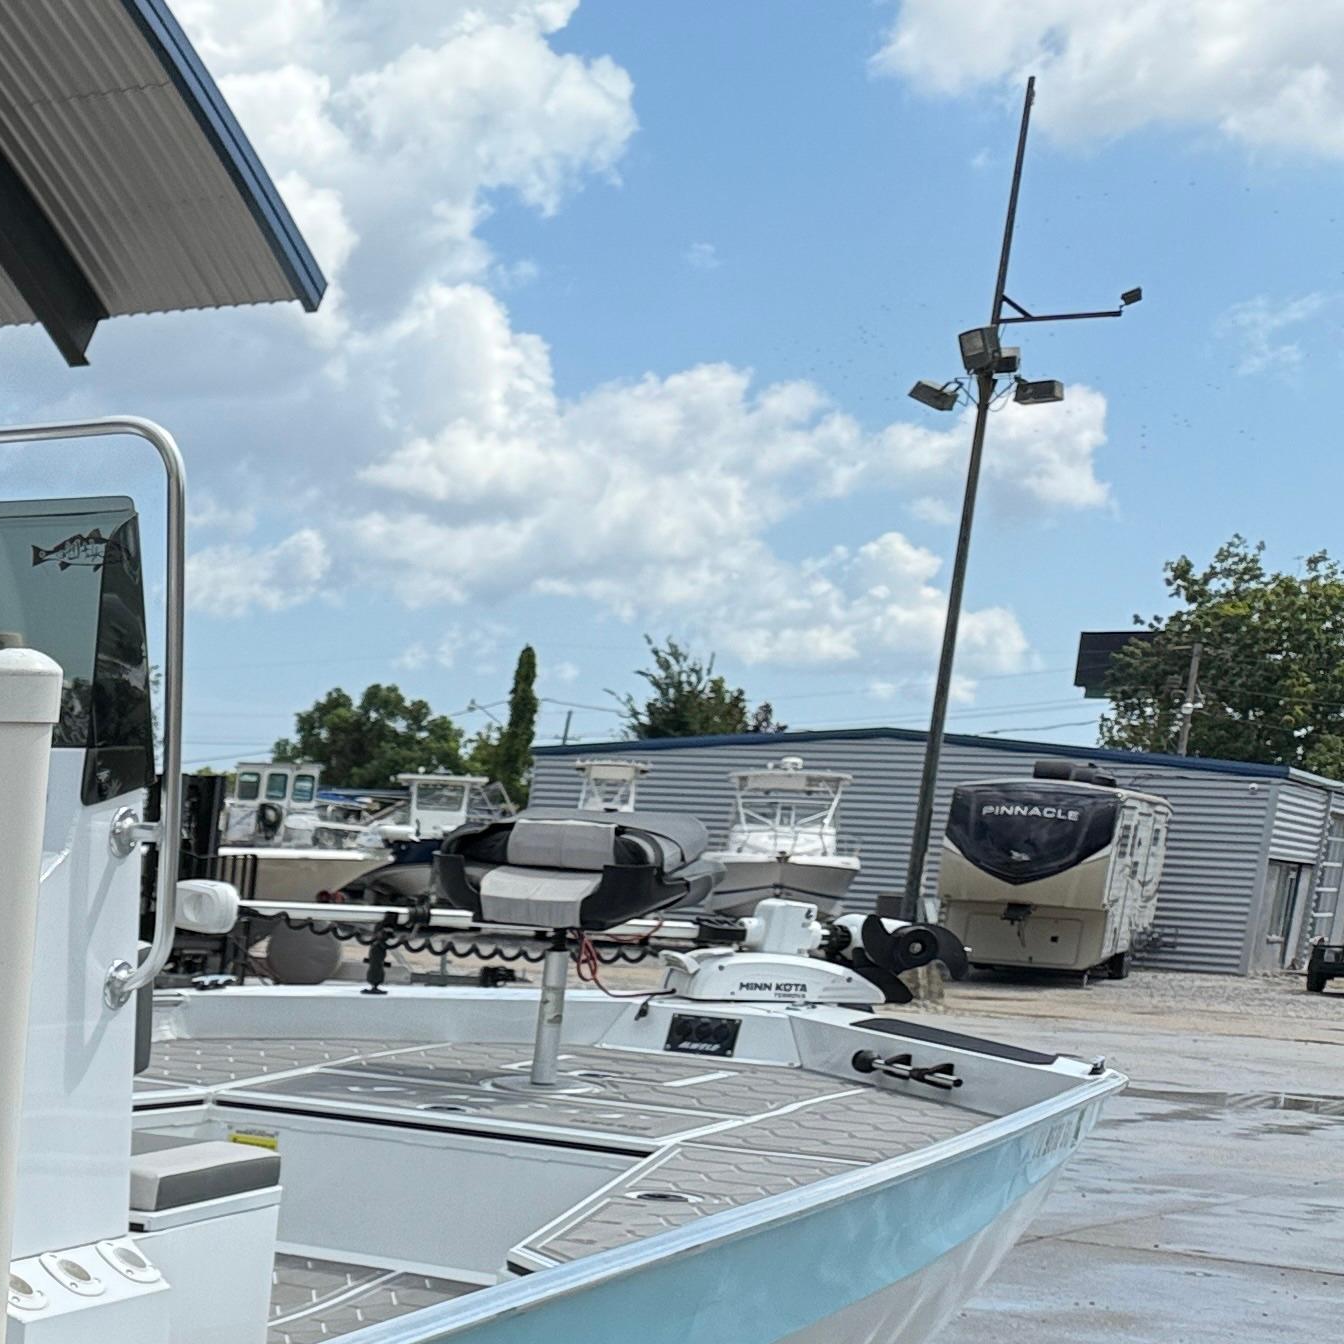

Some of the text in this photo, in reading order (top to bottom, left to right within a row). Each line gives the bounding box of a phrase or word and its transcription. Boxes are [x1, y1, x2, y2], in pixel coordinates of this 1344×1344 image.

[982, 805, 1080, 822] PINNACLE
[738, 982, 808, 993] MINN KOTA
